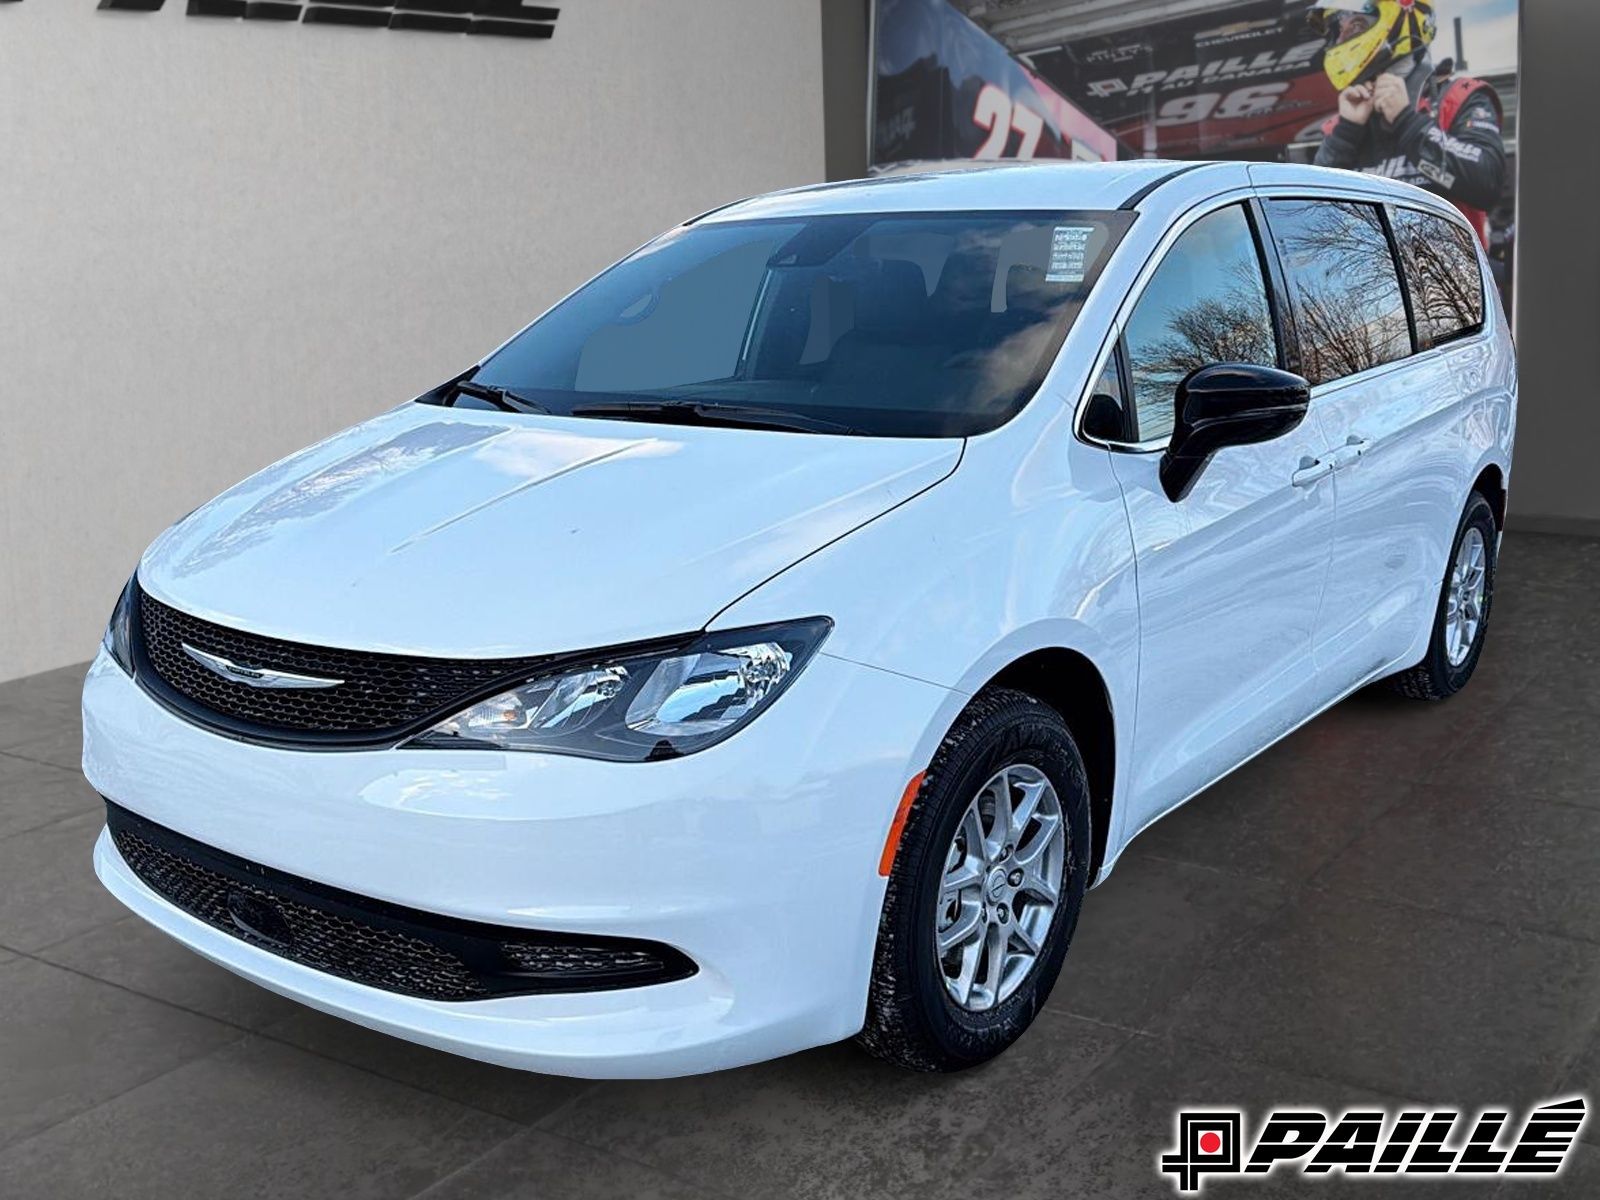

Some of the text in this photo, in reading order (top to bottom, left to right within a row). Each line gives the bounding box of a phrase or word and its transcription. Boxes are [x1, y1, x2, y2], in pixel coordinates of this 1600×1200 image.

[1196, 27, 1283, 47] CHEVROLET
[1202, 61, 1311, 83] CANADA
[972, 81, 1044, 161] 27
[1155, 82, 1290, 128] 96
